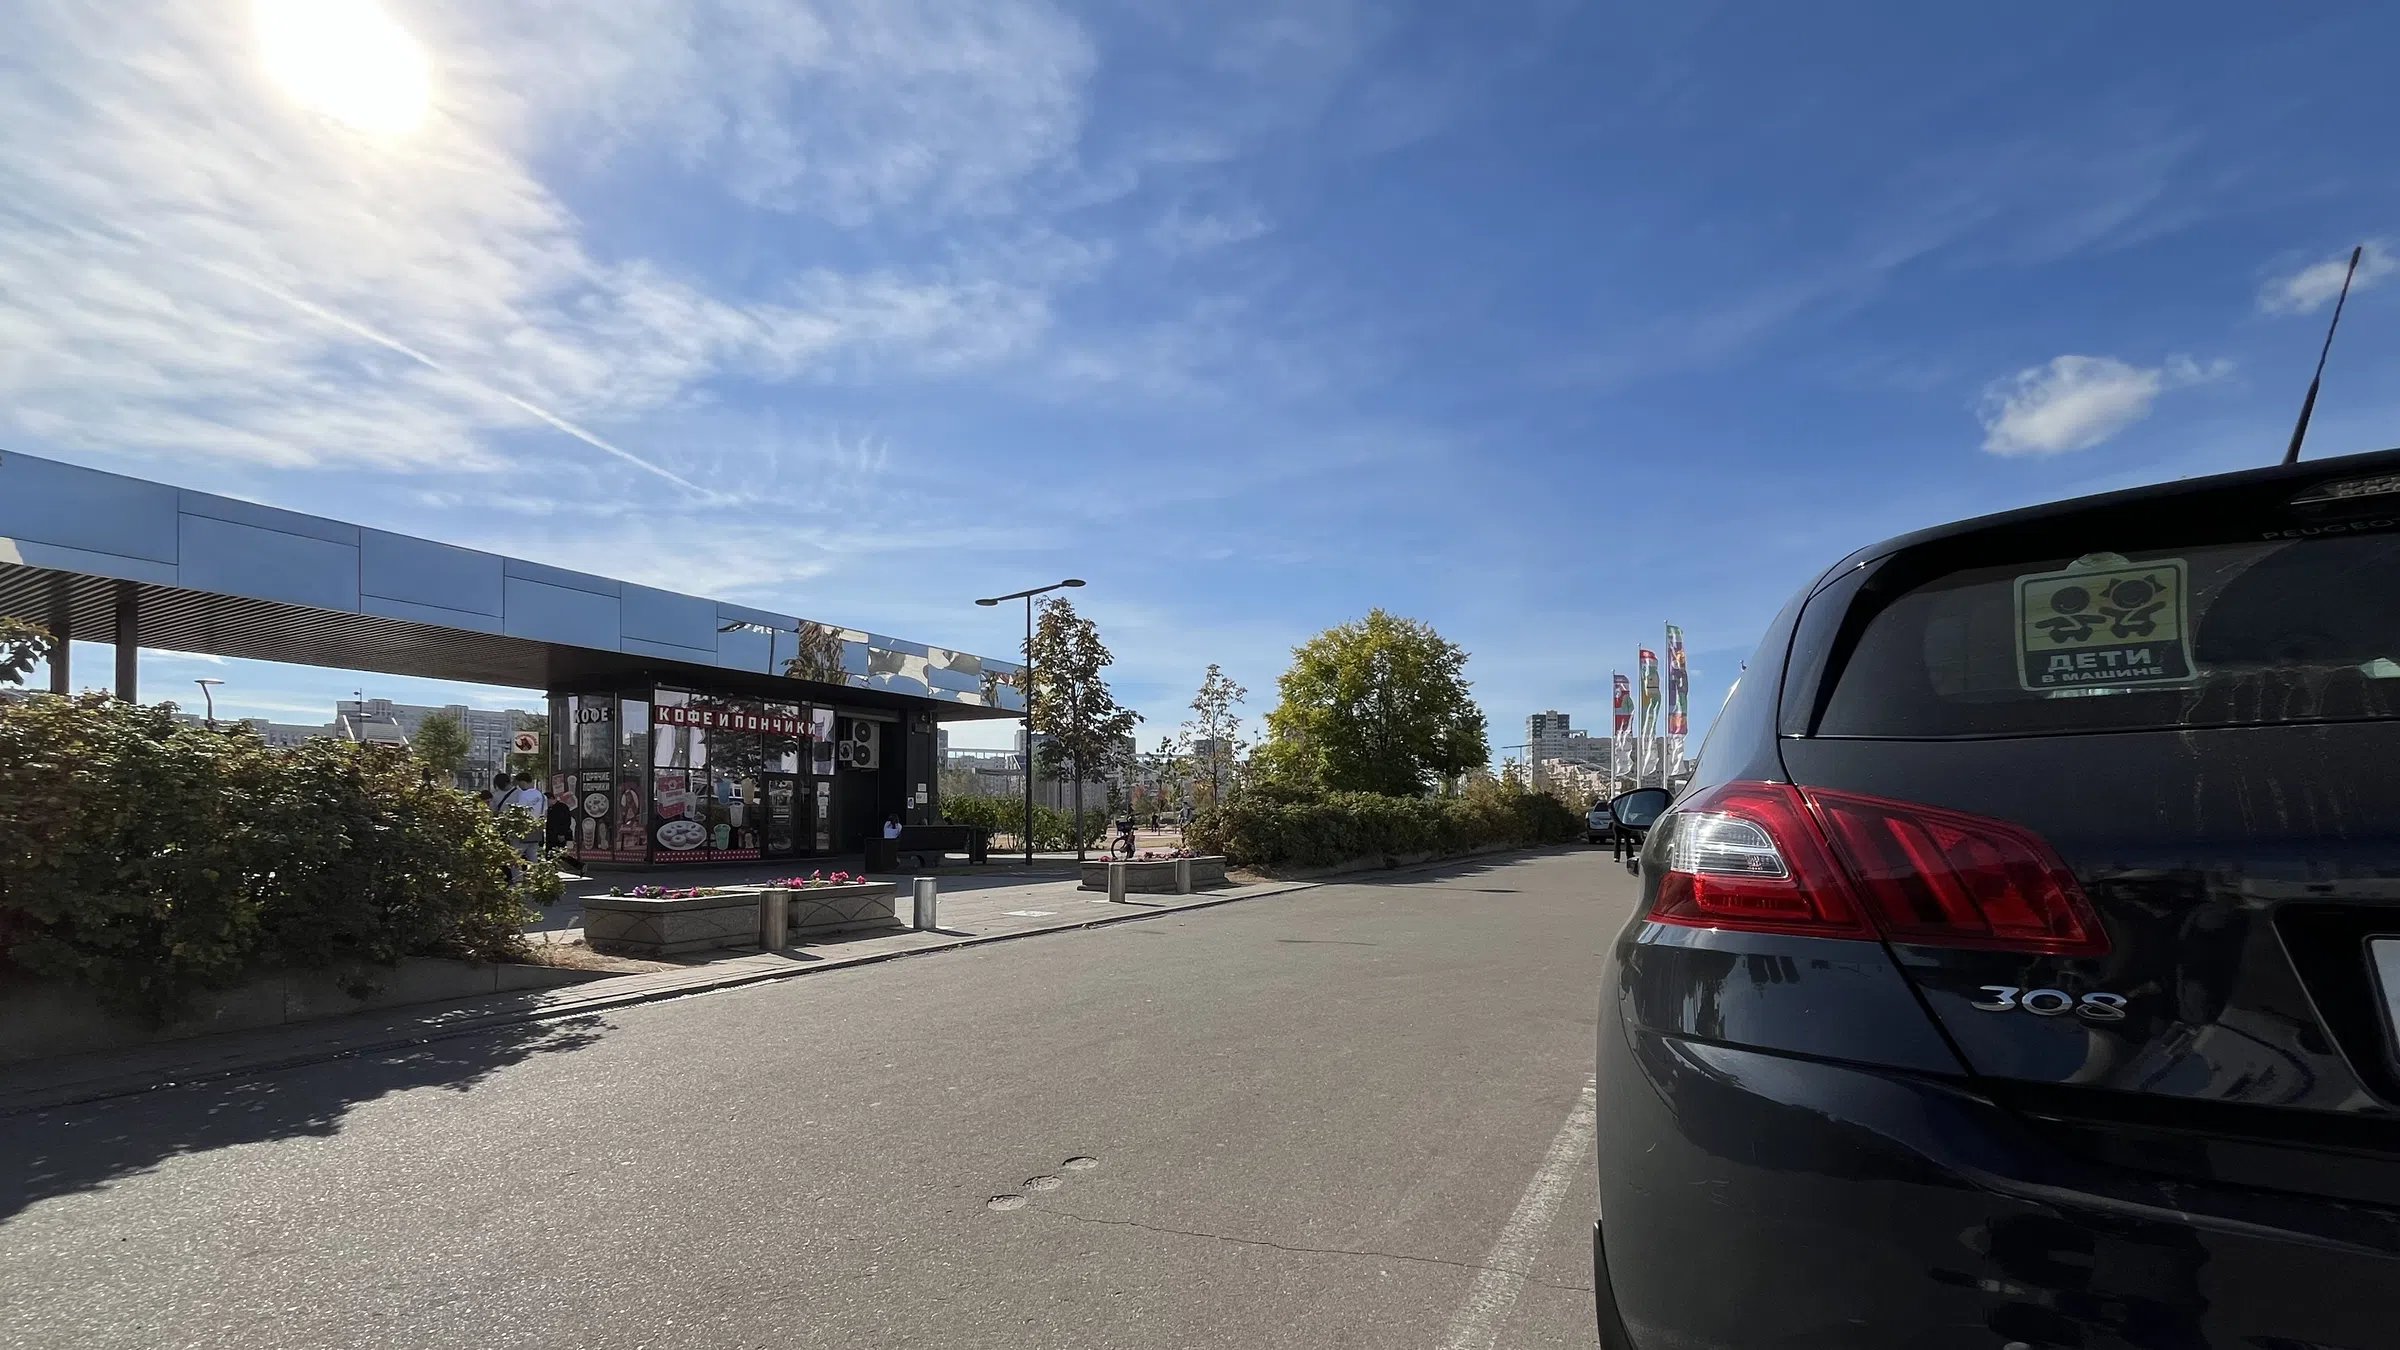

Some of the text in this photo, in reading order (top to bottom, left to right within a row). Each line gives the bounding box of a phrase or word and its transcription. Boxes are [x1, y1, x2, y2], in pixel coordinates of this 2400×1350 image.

[2047, 648, 2152, 672] ДЕТИ
[2041, 666, 2165, 683] В МАШИНЕ
[574, 706, 609, 723] КОФЕ
[659, 706, 713, 726] КОФЕ
[734, 715, 816, 735] ПОНЧИКИ
[1970, 985, 2129, 1021] 308
